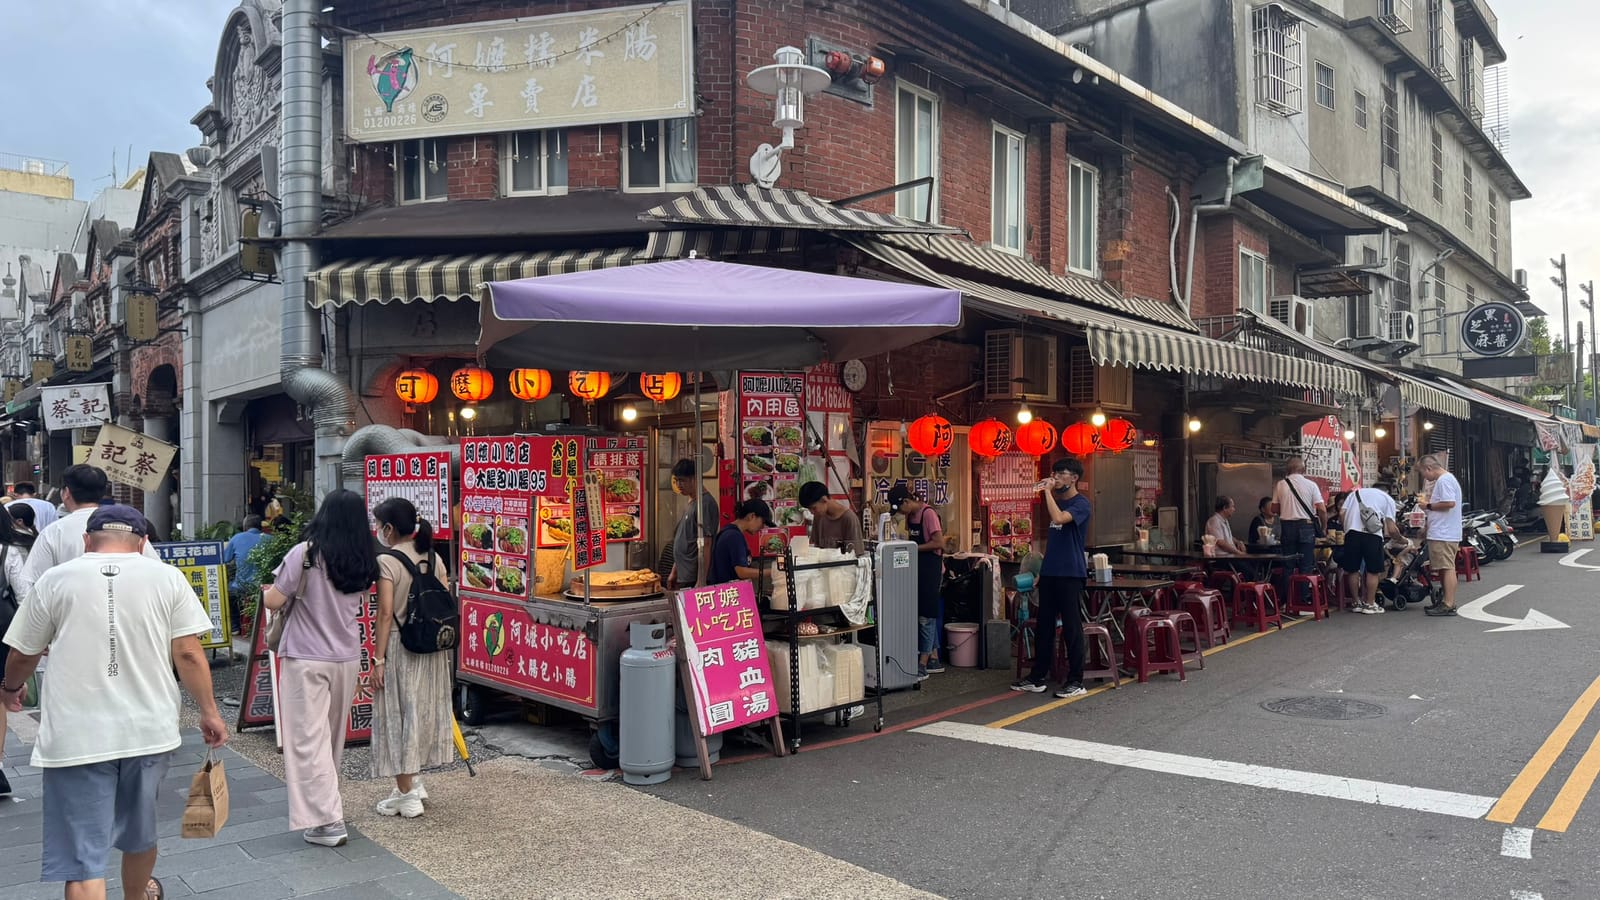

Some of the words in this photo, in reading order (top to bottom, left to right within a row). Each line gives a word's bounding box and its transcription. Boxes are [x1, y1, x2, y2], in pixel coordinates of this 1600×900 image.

[465, 74, 599, 118] 專賣店
[364, 114, 417, 128] 01200226
[743, 376, 803, 393] 阿嬤小吃店
[51, 398, 108, 419] 蔡記
[747, 398, 800, 416] 內用區
[464, 441, 530, 464] 阿嬤小吃店
[551, 439, 563, 477] 大腸
[566, 439, 578, 478] 香腸
[594, 452, 639, 466] 請排隊
[368, 456, 437, 478] 阿嬤小吃店
[476, 467, 529, 491] 大腸包小腸
[530, 469, 546, 492] 95
[695, 587, 740, 613] 阿嬤
[468, 607, 478, 652] 祖傳
[689, 607, 754, 637] 小吃店
[510, 618, 587, 660] 阿嬤小吃店
[517, 656, 577, 689] 大腸包小腸
[732, 638, 770, 717] 豬血湯
